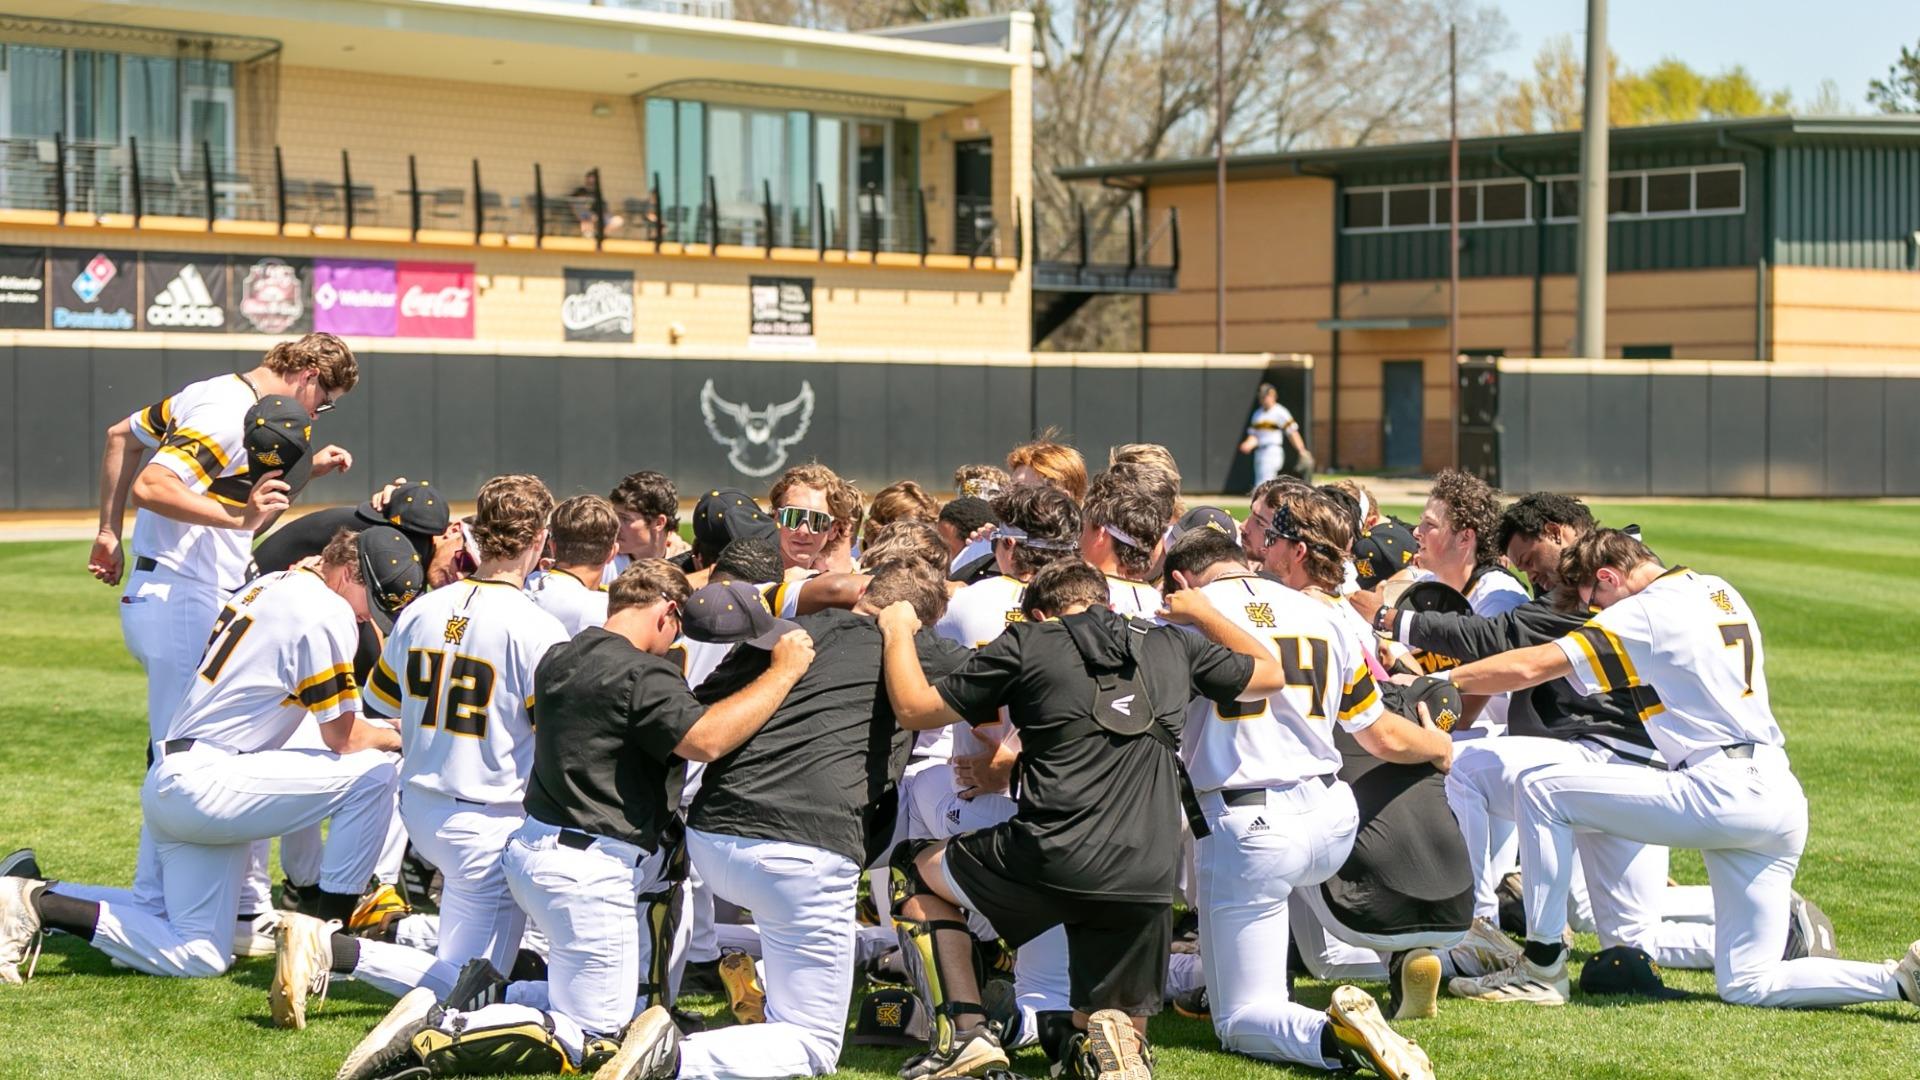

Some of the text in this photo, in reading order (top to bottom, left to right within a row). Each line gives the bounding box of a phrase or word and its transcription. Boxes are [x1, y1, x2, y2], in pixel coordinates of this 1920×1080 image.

[147, 303, 225, 327] adidas
[406, 648, 497, 740] 42
[1717, 621, 1754, 698] 7
